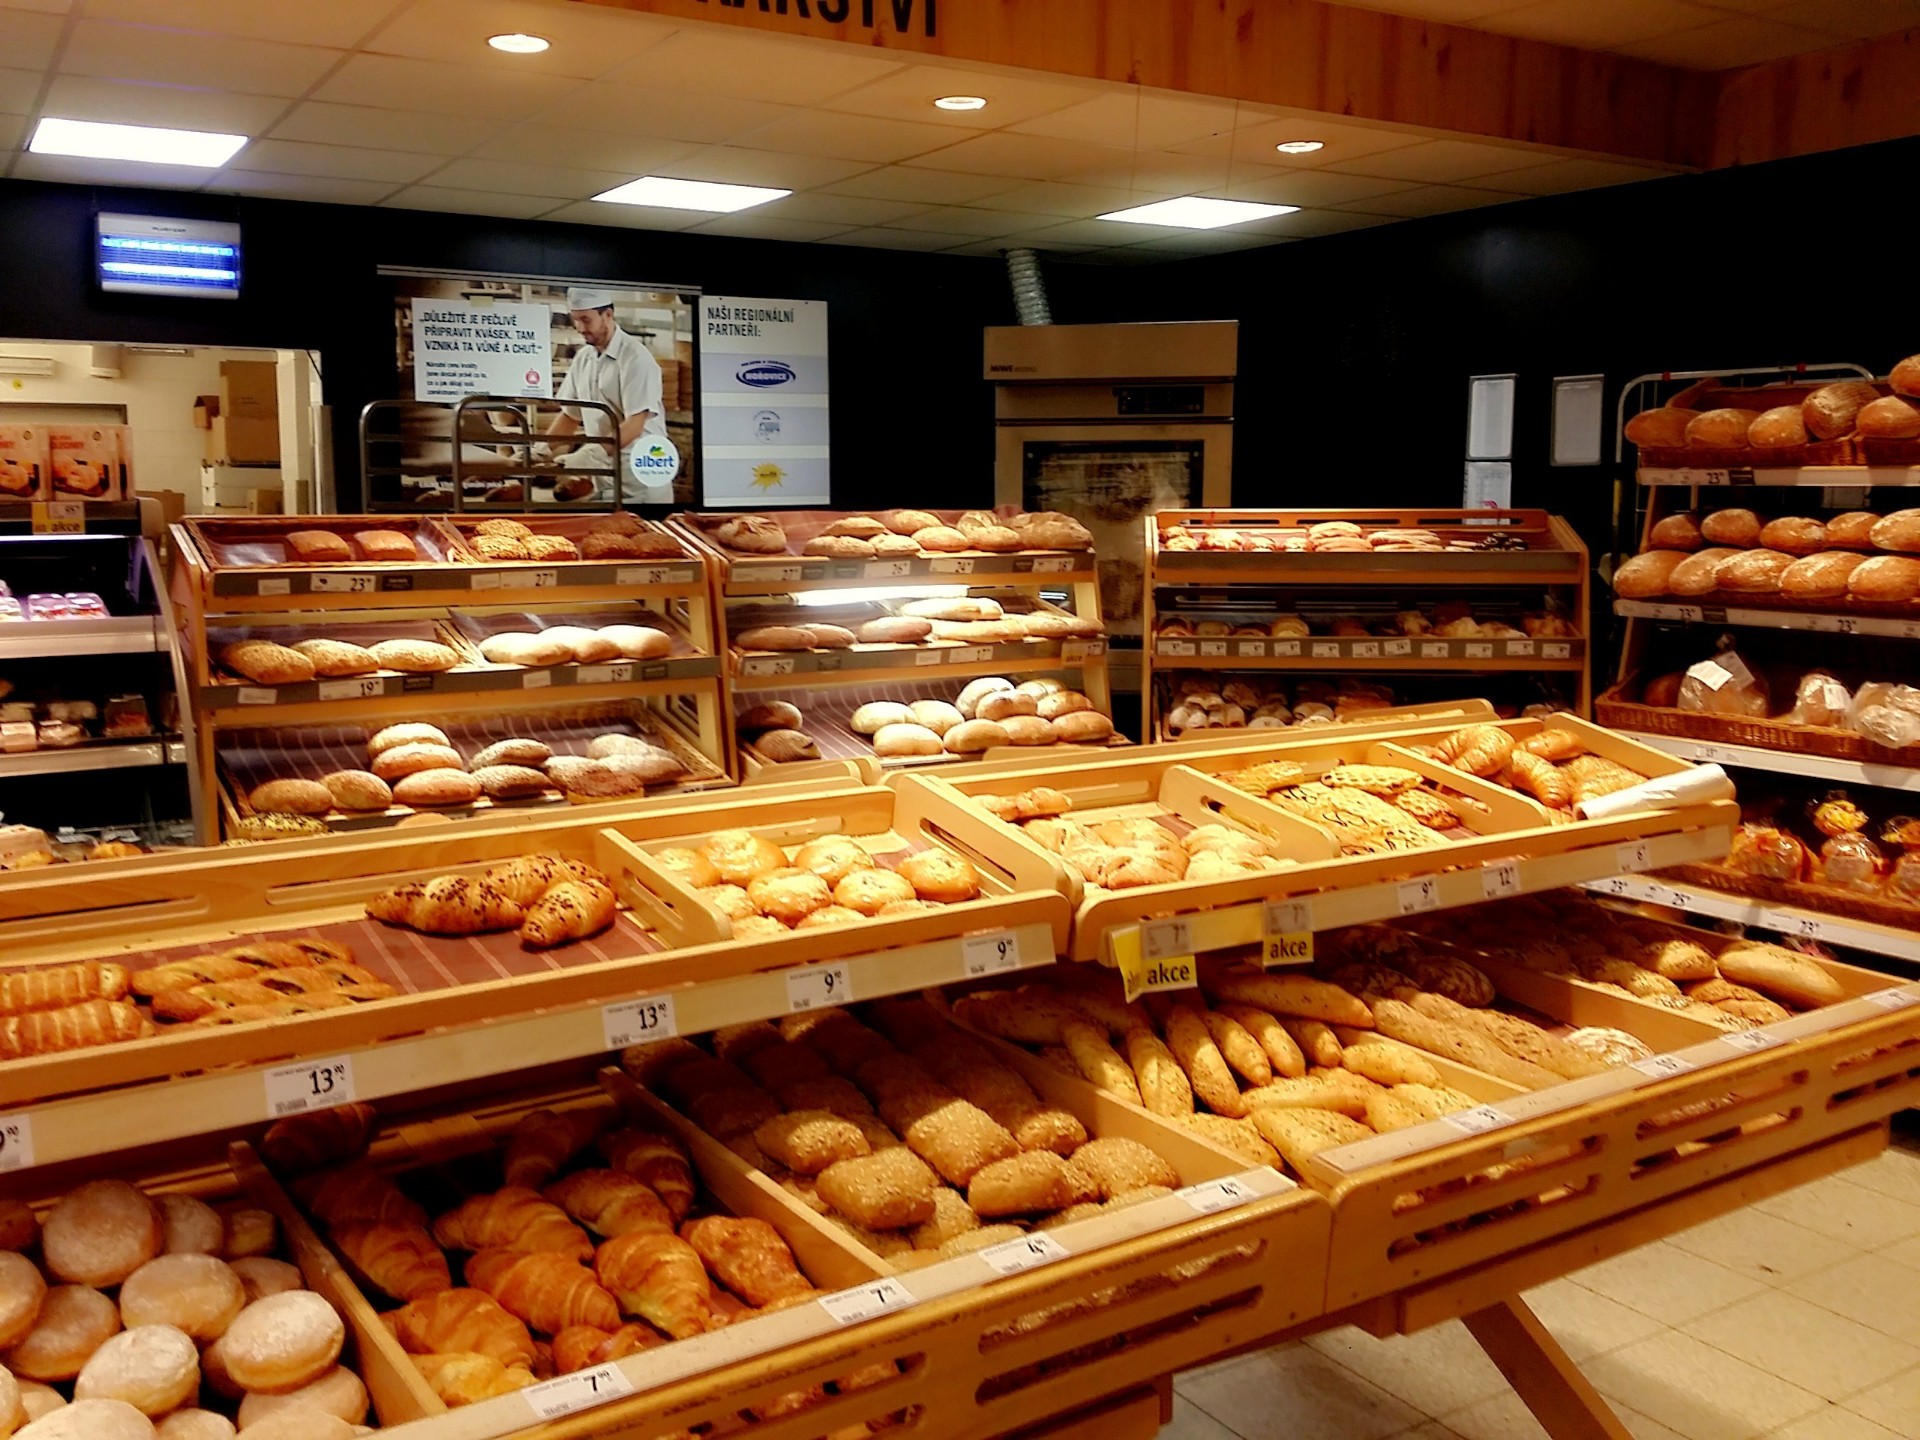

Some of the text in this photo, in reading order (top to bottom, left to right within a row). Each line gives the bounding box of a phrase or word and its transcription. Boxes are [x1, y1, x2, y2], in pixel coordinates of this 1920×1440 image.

[470, 314, 479, 324] JE
[708, 305, 794, 323] NAŠI REGIONÁLNÍ
[516, 330, 535, 340] TAM
[708, 322, 762, 337] PARTNEŘI:
[462, 342, 474, 352] TA
[504, 344, 510, 353] A
[635, 455, 674, 467] albert
[1270, 938, 1307, 959] akce
[1147, 963, 1190, 985] akce
